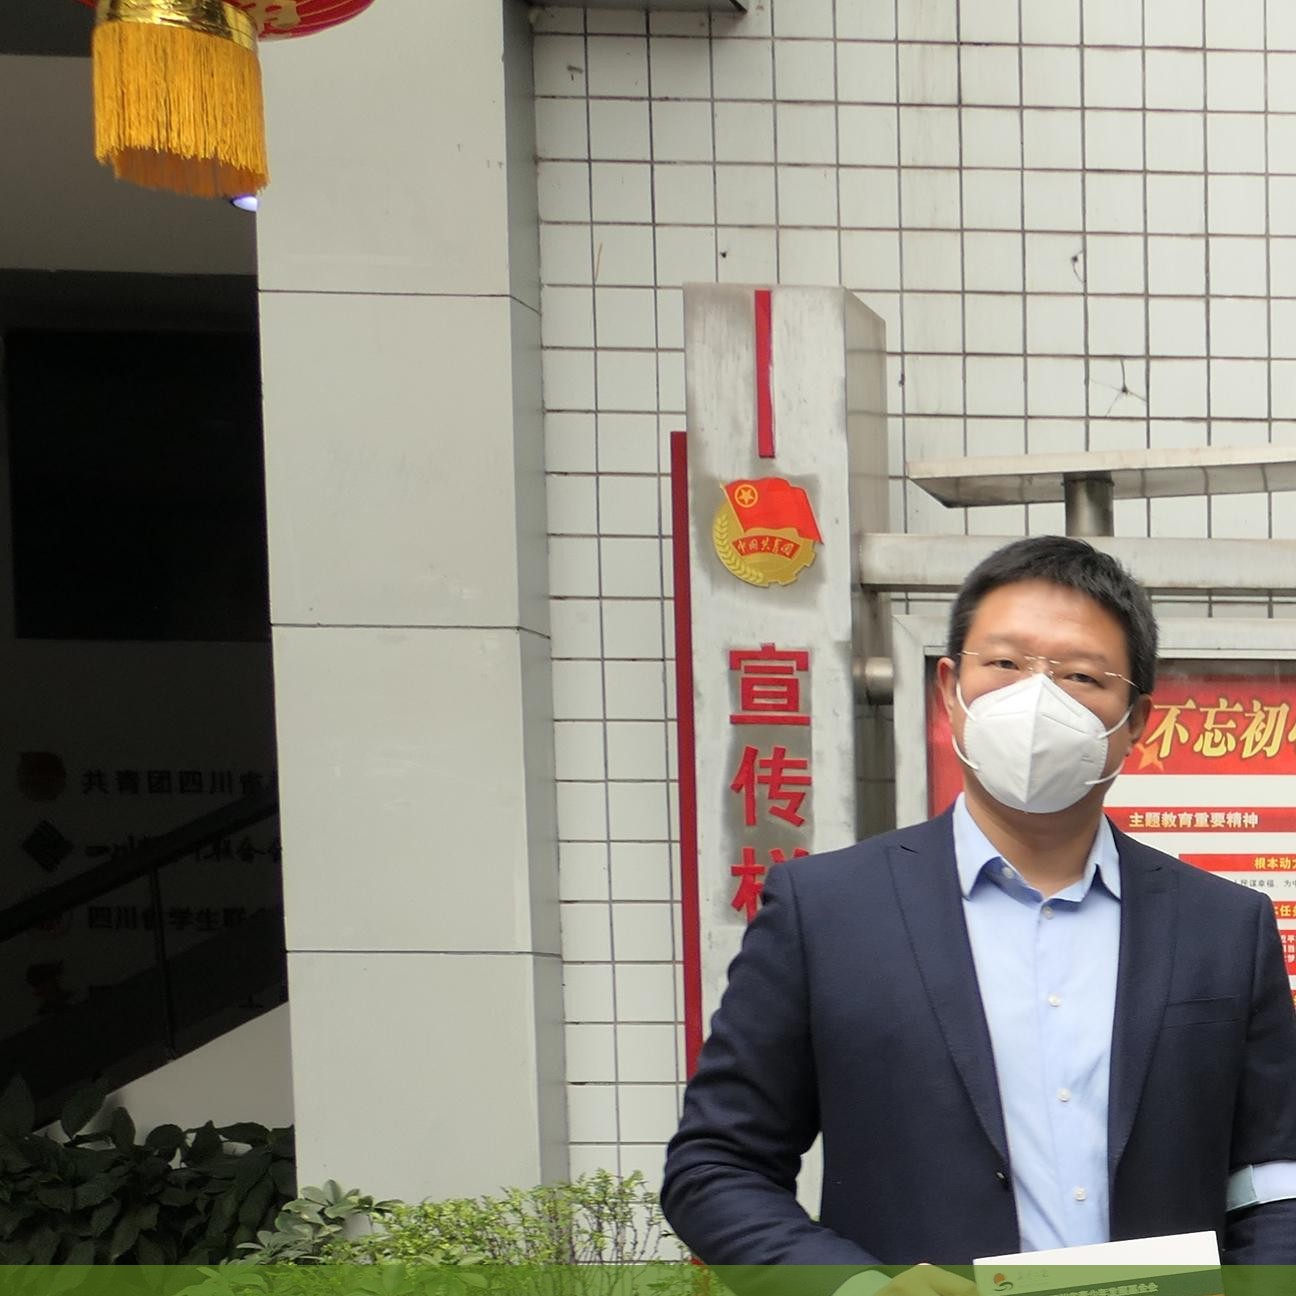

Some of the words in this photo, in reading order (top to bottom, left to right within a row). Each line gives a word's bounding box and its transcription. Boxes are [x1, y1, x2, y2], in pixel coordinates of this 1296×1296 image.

[1129, 812, 1259, 829] 主题教育重要精神
